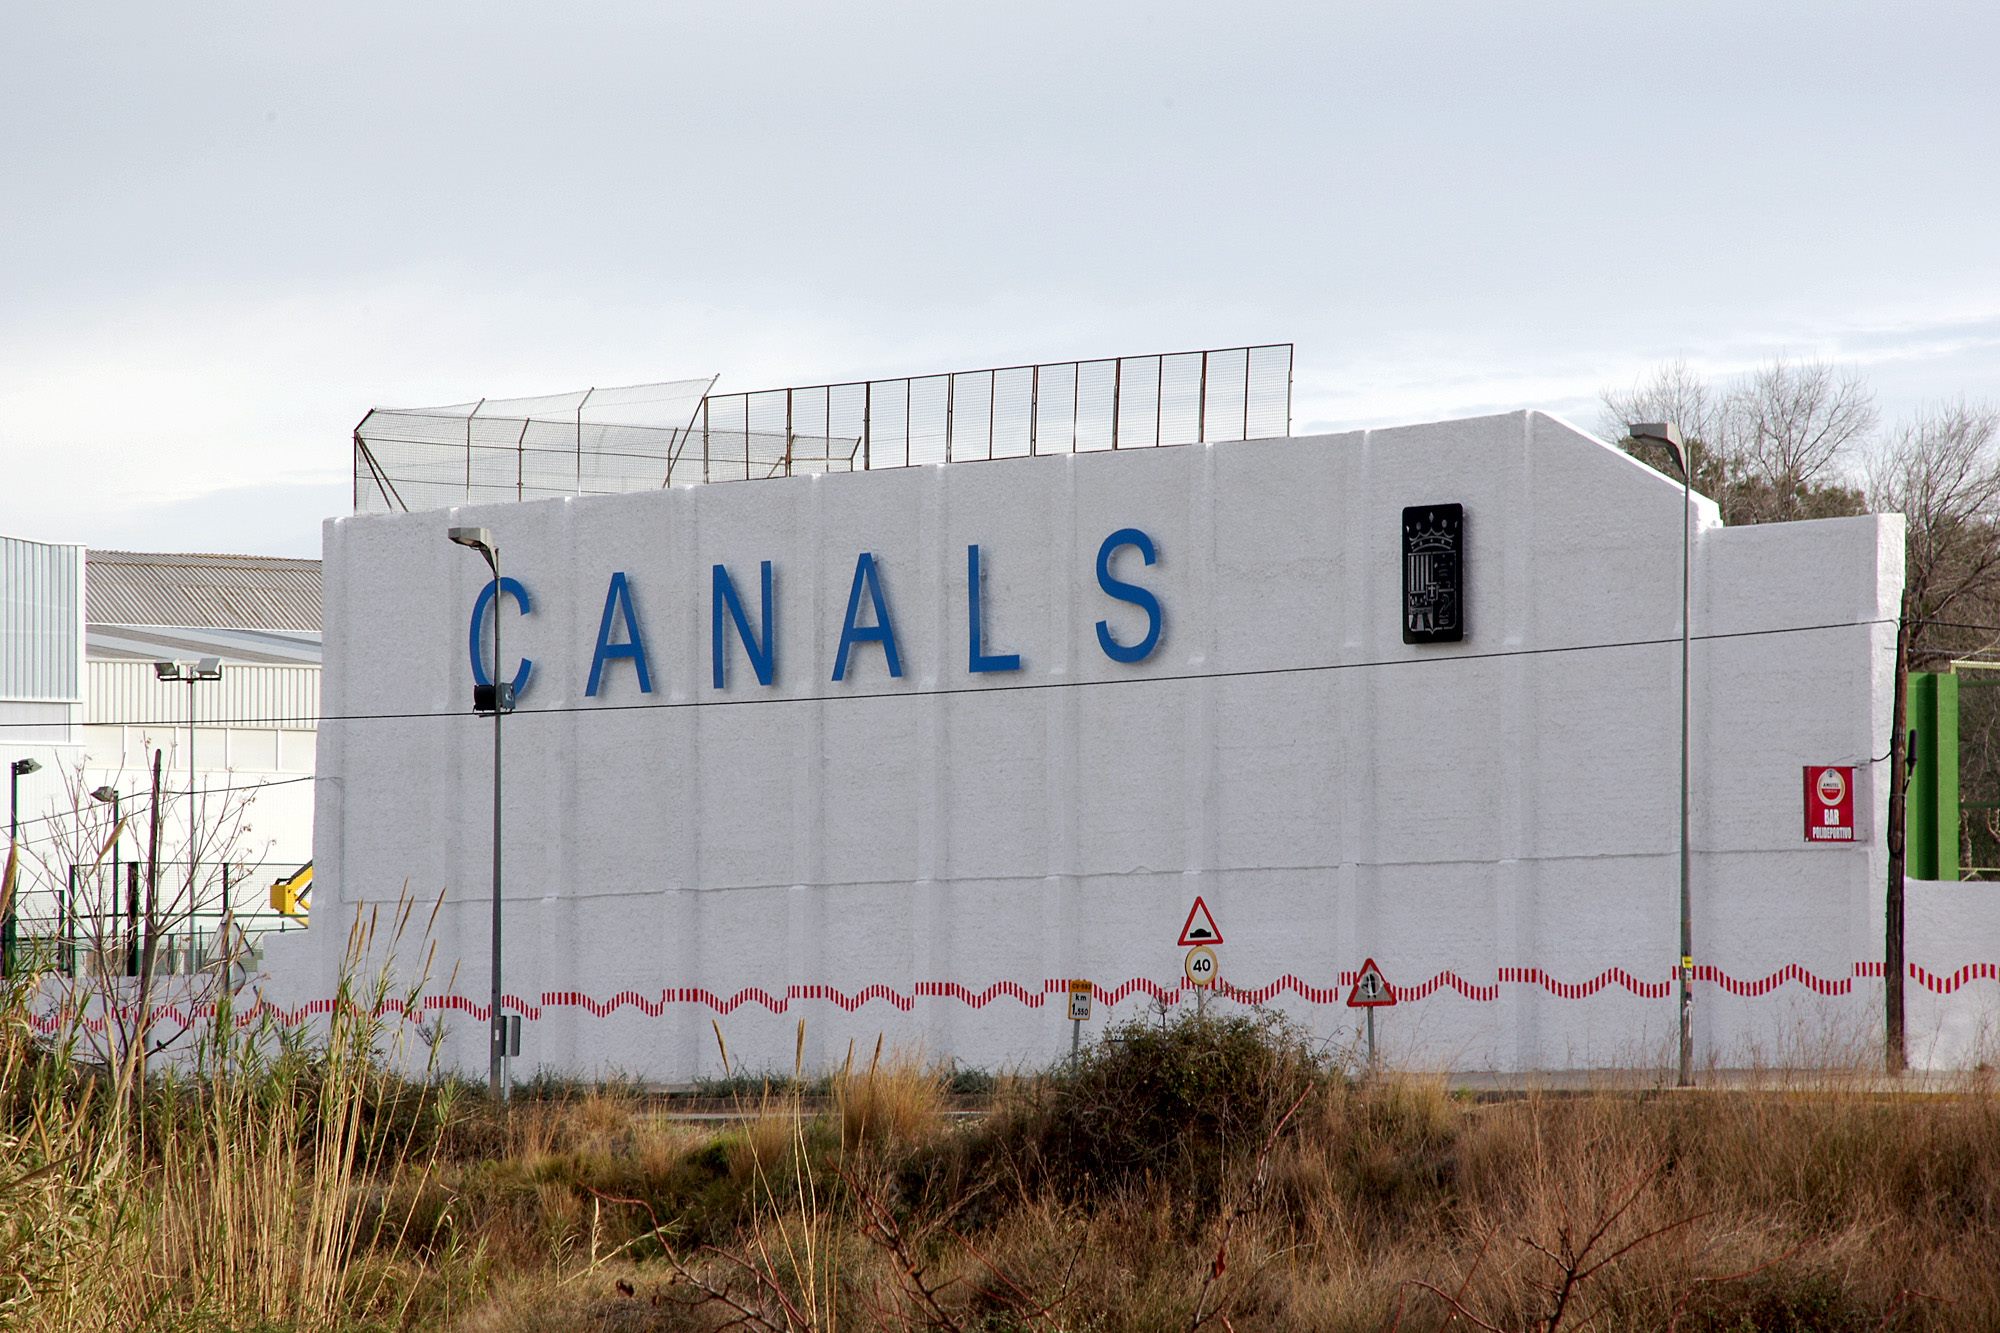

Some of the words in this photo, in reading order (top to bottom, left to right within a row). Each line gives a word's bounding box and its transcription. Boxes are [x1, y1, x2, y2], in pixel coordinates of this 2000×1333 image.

[469, 528, 1162, 697] CANALS
[1824, 808, 1840, 826] BAR
[1812, 826, 1852, 839] POLIDEPORTIVO
[1192, 958, 1211, 972] 40
[1075, 993, 1087, 1001] km
